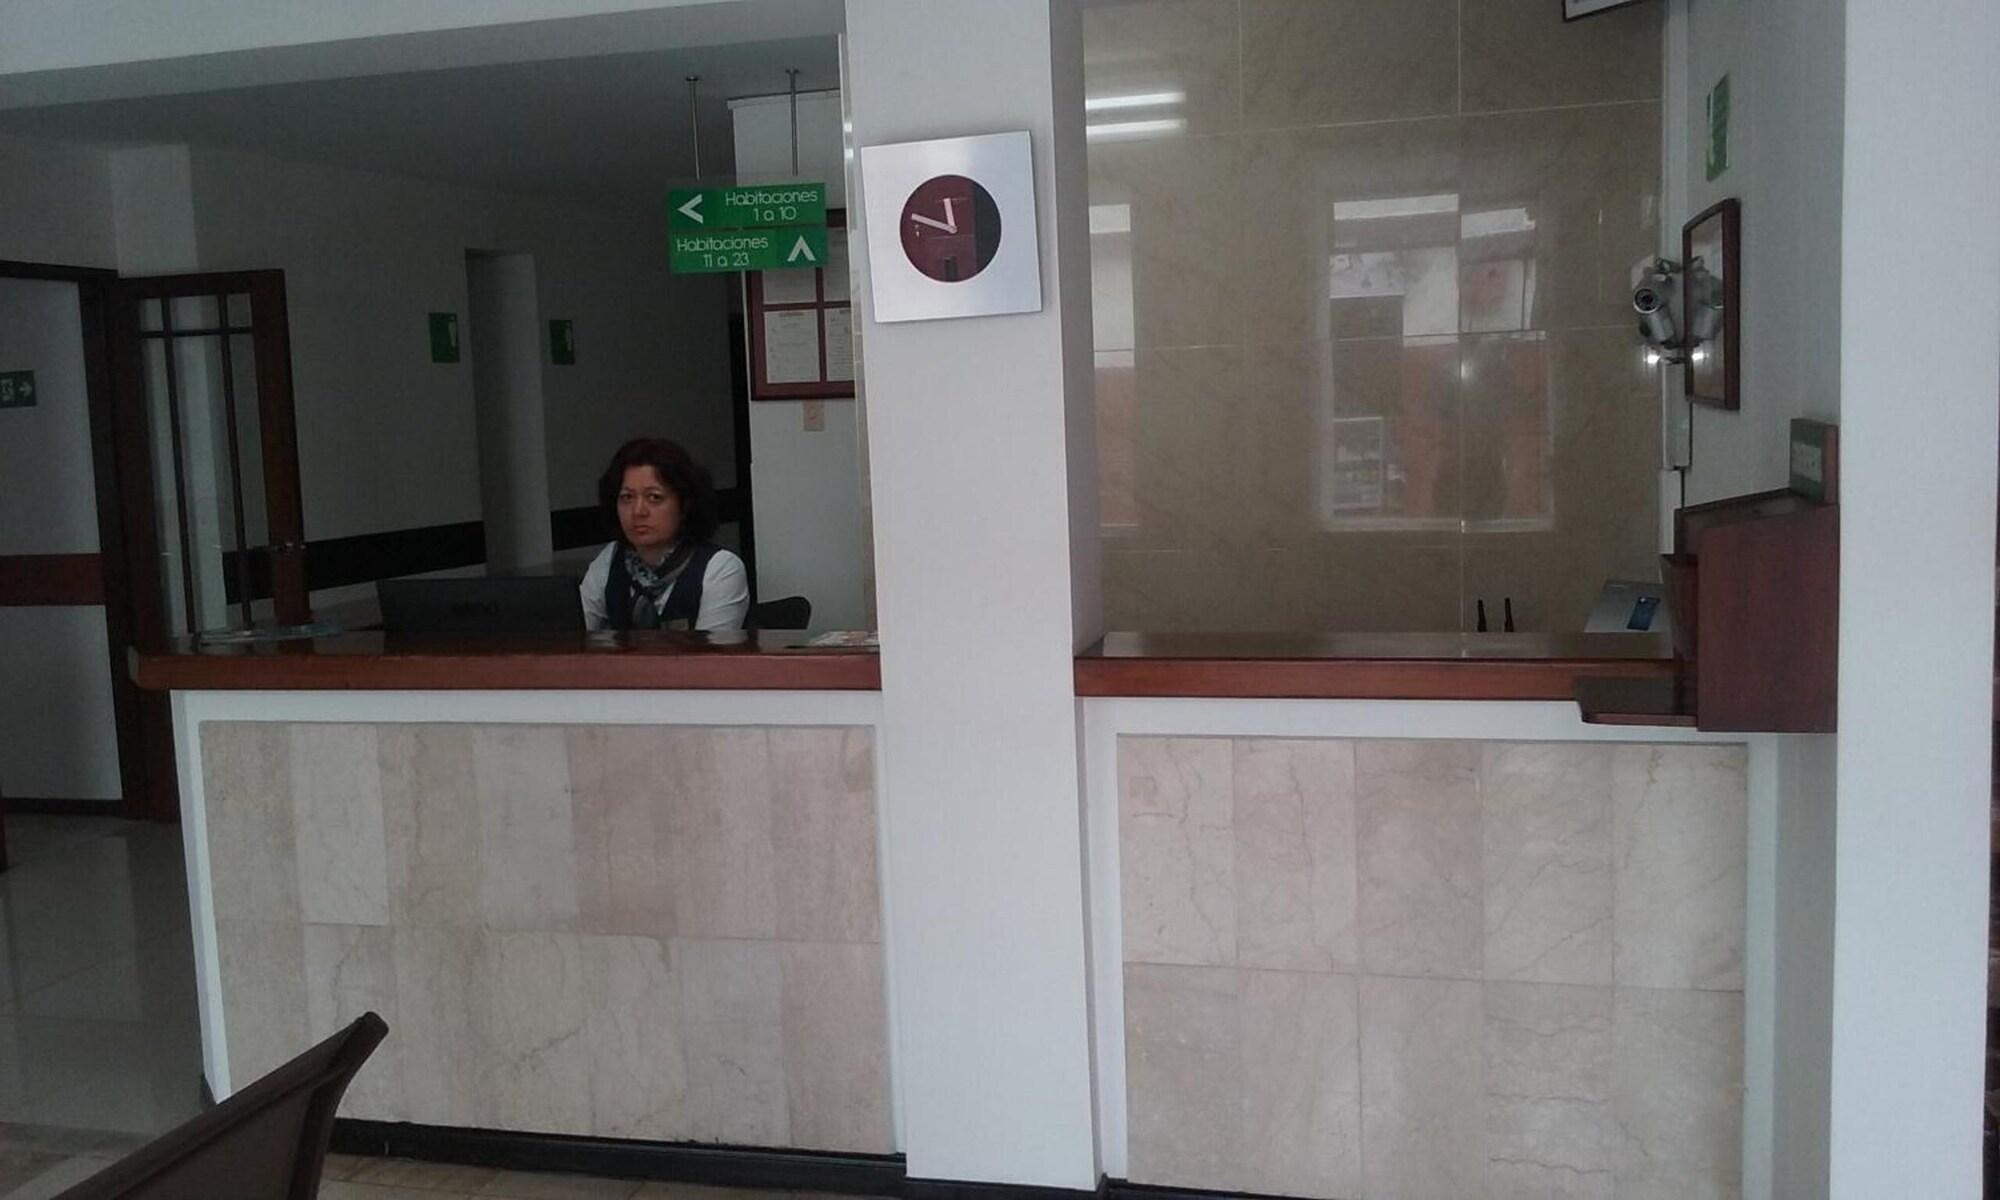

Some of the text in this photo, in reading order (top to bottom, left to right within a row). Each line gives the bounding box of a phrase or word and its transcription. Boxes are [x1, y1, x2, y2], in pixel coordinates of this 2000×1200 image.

[725, 190, 818, 206] Habitaciones
[754, 206, 797, 221] 1 a 10
[676, 236, 769, 252] Habitaciones
[704, 252, 750, 268] 11 a 23
